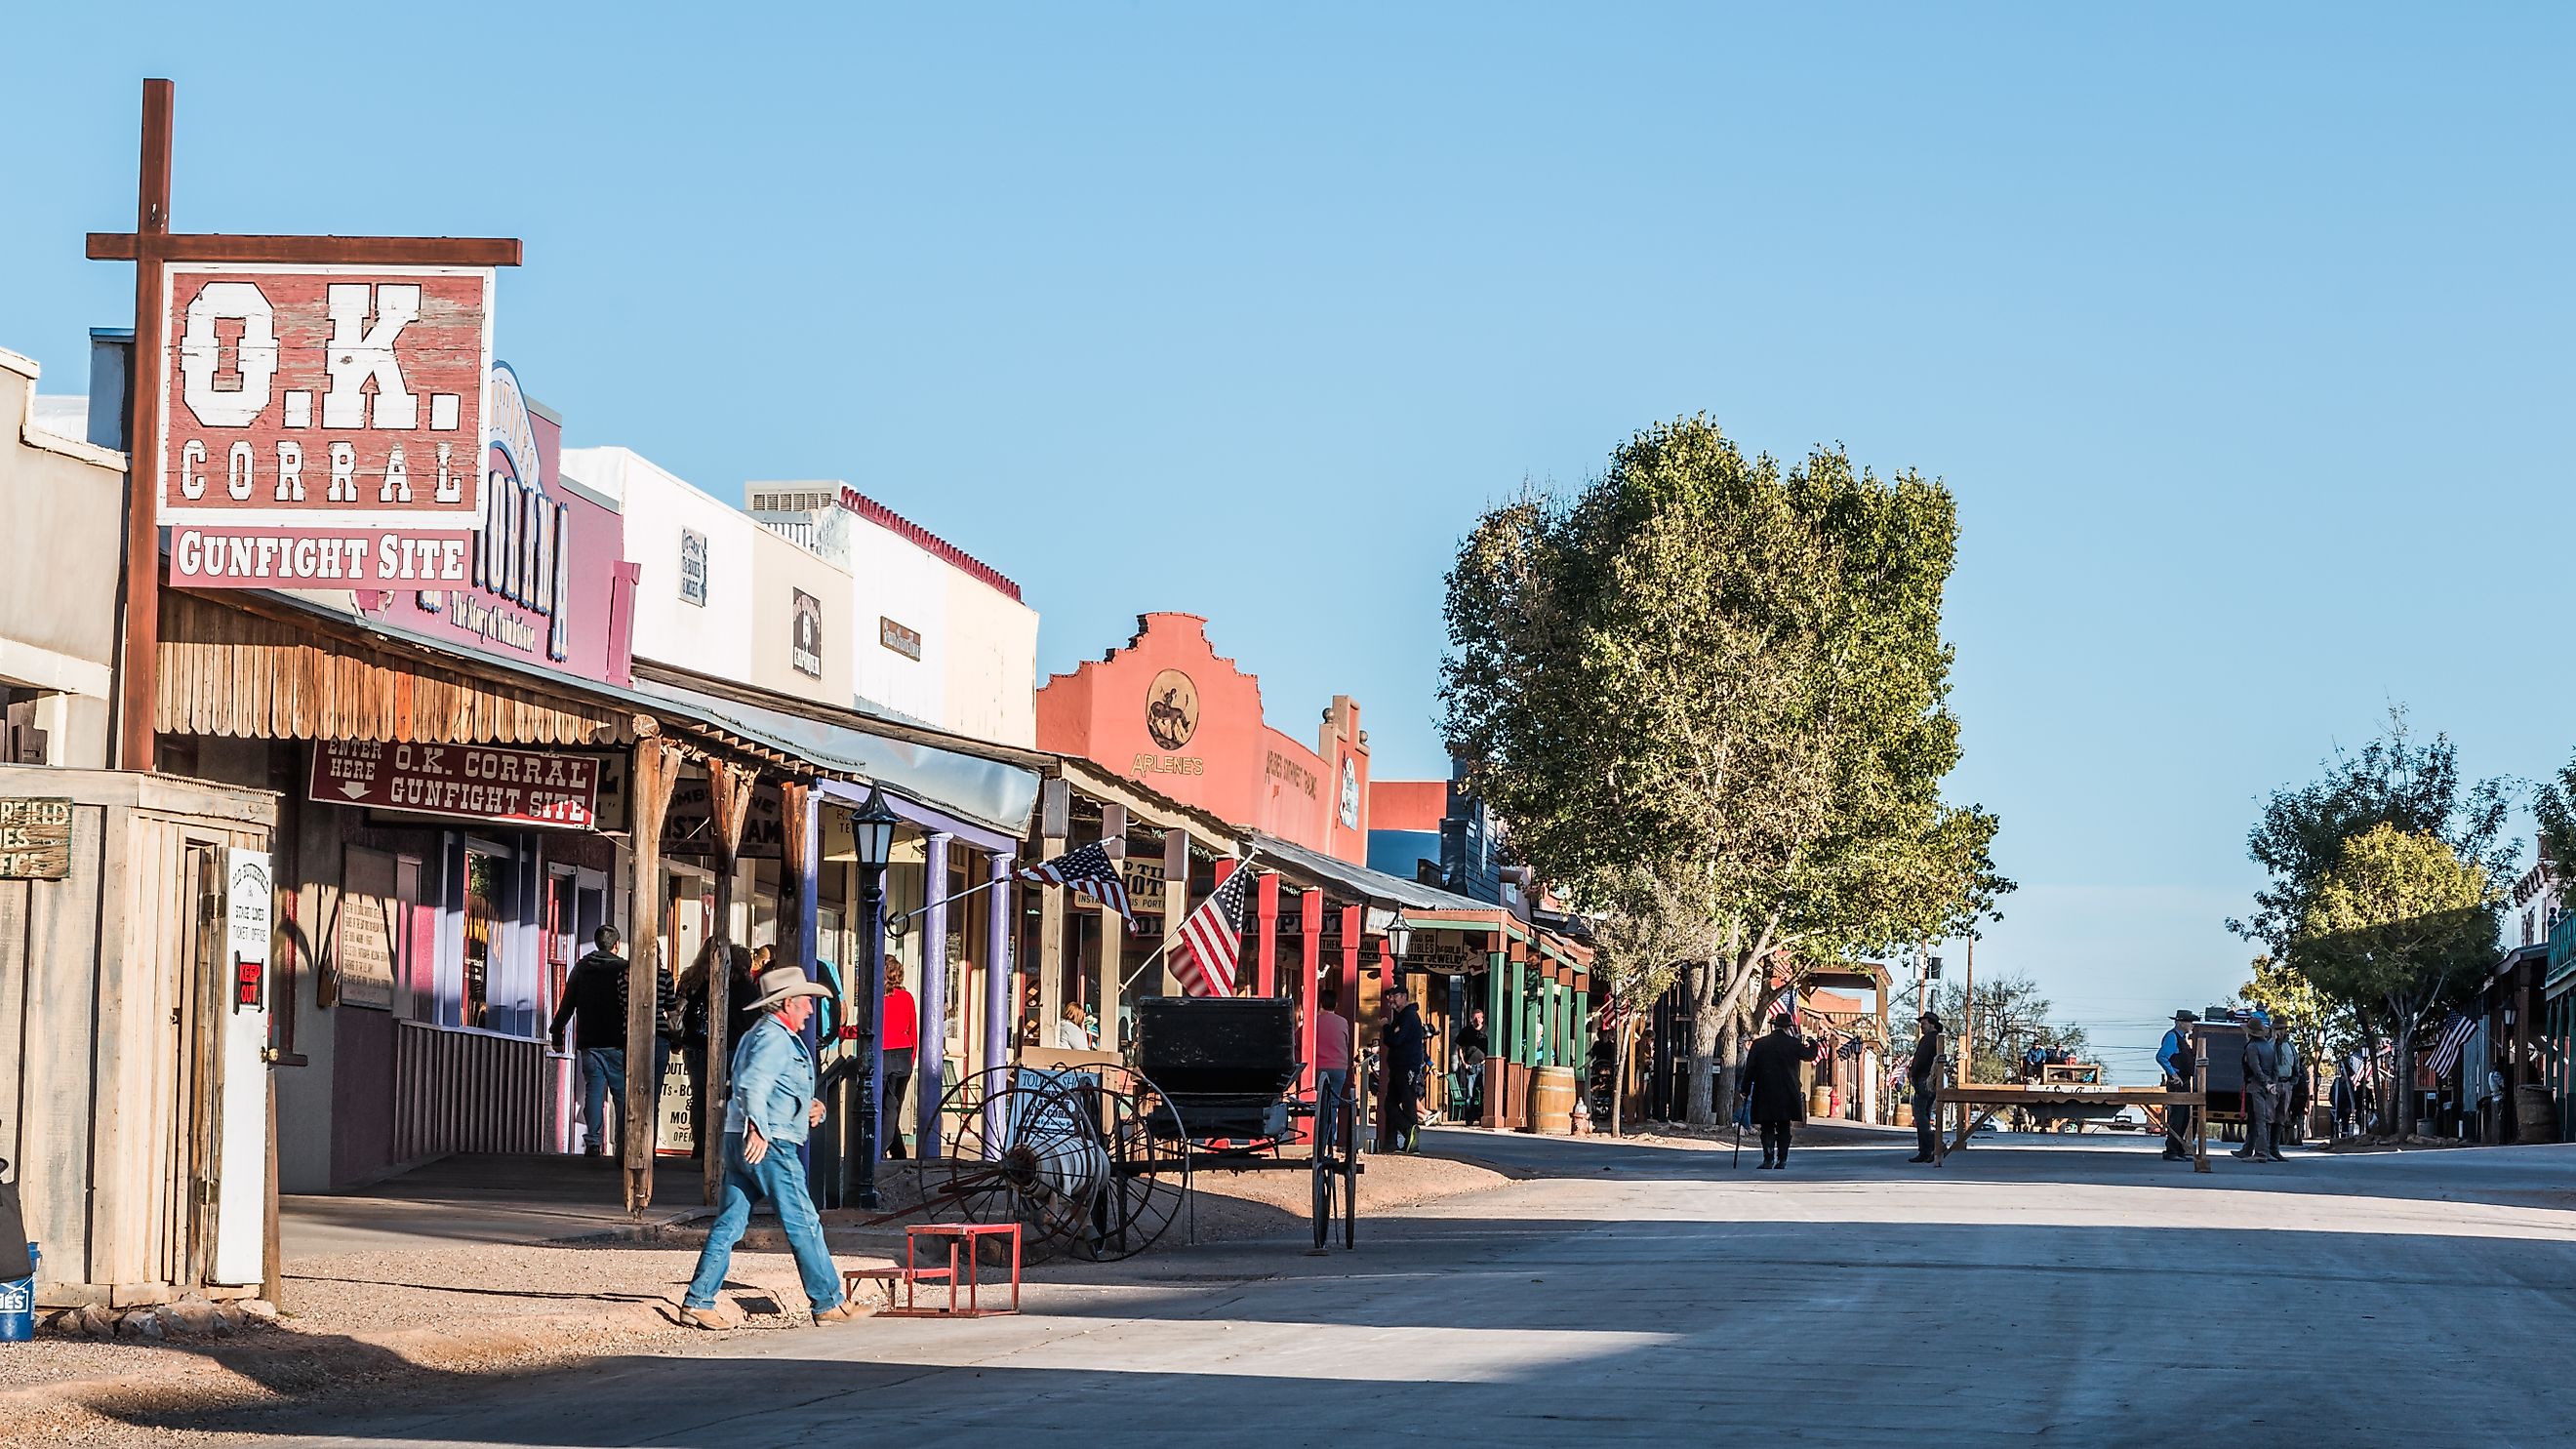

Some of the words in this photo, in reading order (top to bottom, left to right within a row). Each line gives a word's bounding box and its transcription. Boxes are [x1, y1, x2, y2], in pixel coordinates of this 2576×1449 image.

[180, 281, 461, 431] O.K.
[181, 439, 462, 503] CORRAL
[178, 531, 368, 578] GUNFIGHT
[378, 534, 464, 580] SITE
[451, 590, 467, 628] The
[467, 595, 488, 644] Story
[488, 606, 498, 639] of
[328, 738, 382, 759] ENTER
[395, 745, 453, 775] O.K.
[330, 758, 376, 781] HERE
[1130, 754, 1204, 778] ARLENE'S
[390, 777, 521, 815] GUNFIGHT
[529, 790, 585, 822] SITE
[0, 827, 30, 848] ES
[240, 964, 261, 982] KEEP
[241, 985, 258, 1003] OUT
